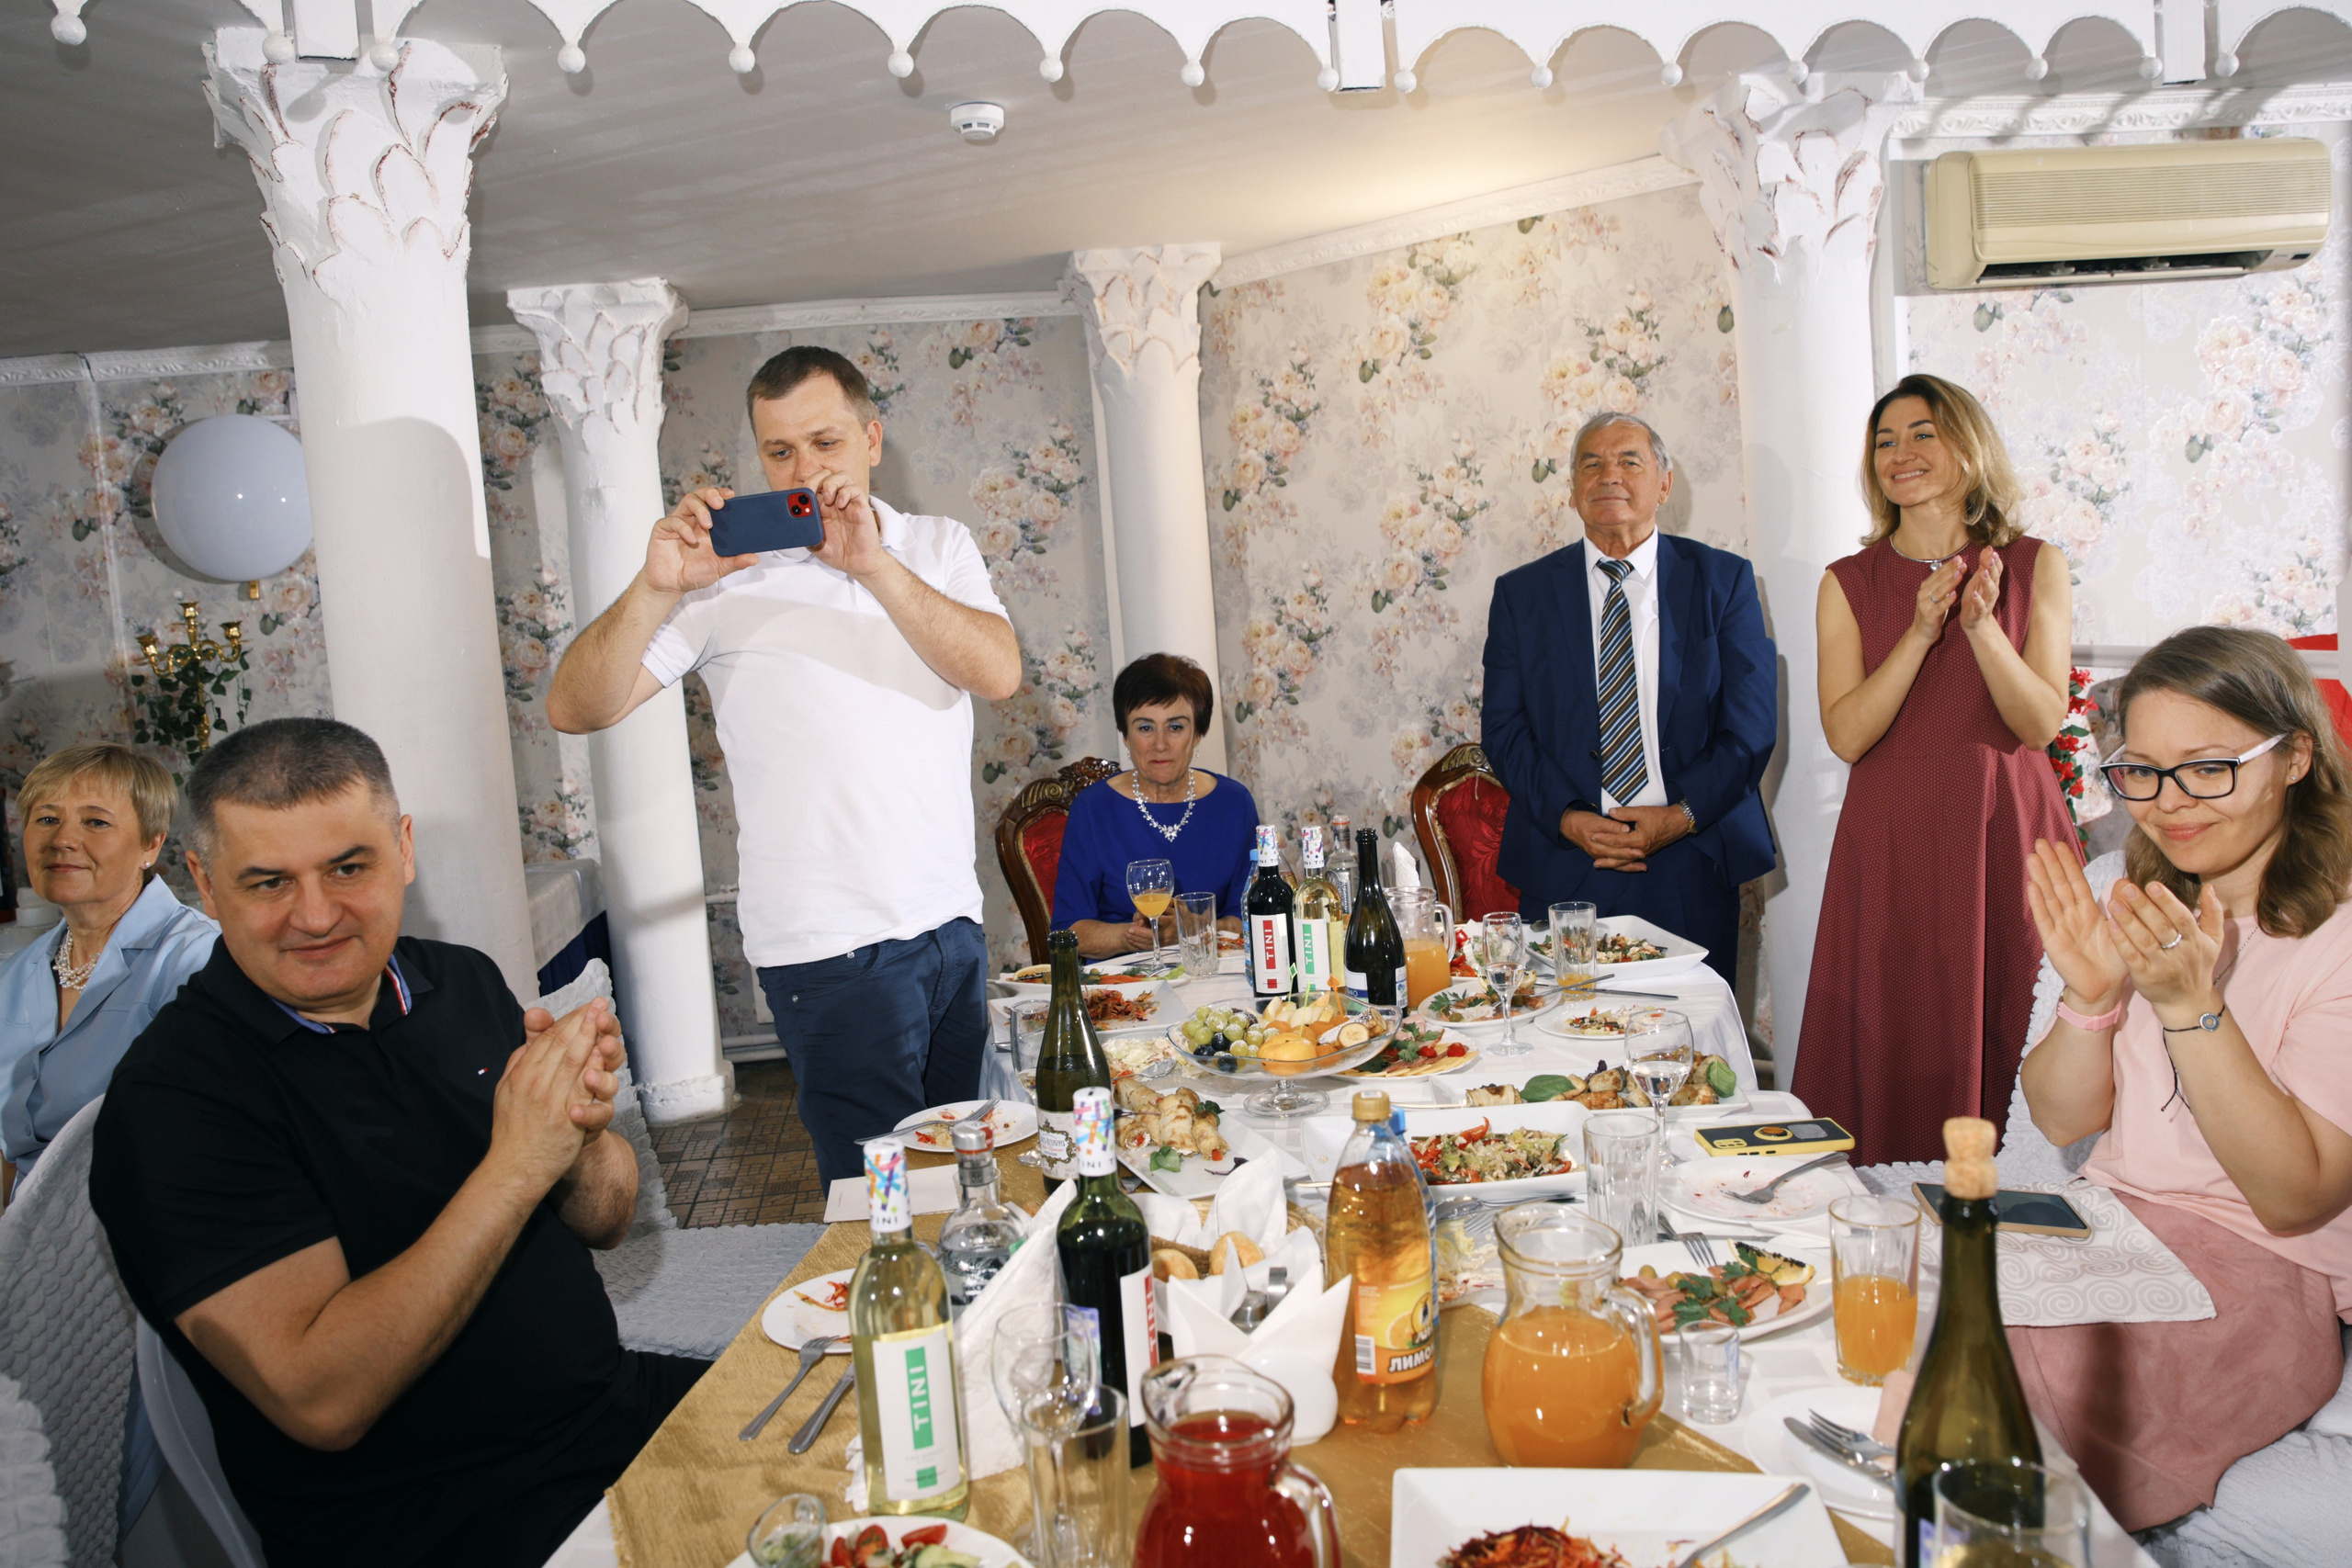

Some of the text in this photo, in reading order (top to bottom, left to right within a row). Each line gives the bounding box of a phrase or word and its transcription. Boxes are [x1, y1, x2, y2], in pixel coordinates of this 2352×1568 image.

[1264, 929, 1274, 961] TINI
[1304, 932, 1313, 964] TINI
[1388, 1344, 1433, 1373] ЛИМО
[909, 1365, 930, 1432] TINI
